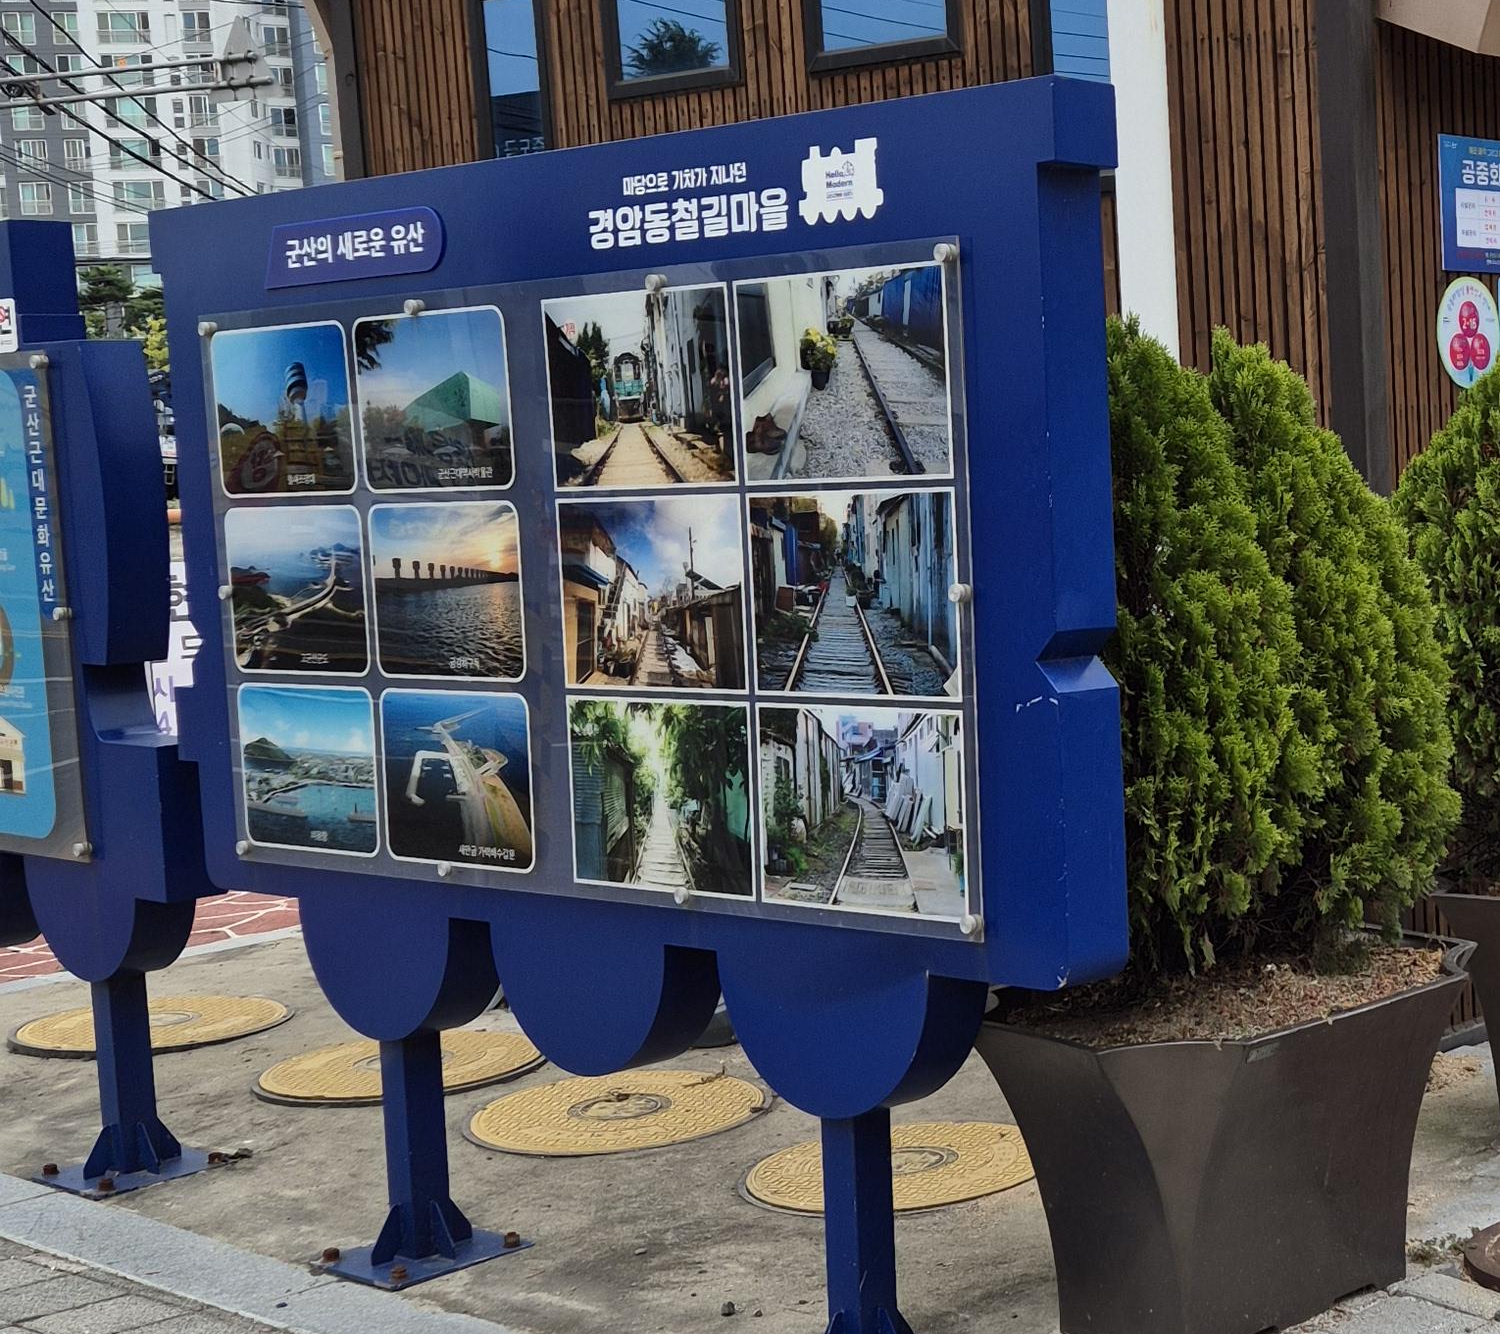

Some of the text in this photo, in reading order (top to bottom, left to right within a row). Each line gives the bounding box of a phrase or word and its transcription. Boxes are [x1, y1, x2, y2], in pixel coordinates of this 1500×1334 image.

[622, 162, 747, 196] 마당으로 기차가 지나던
[285, 221, 426, 269] 군산의 새로운 유산
[588, 187, 789, 251] 경암동철길마을
[23, 385, 55, 603] 군산근대문화유산
